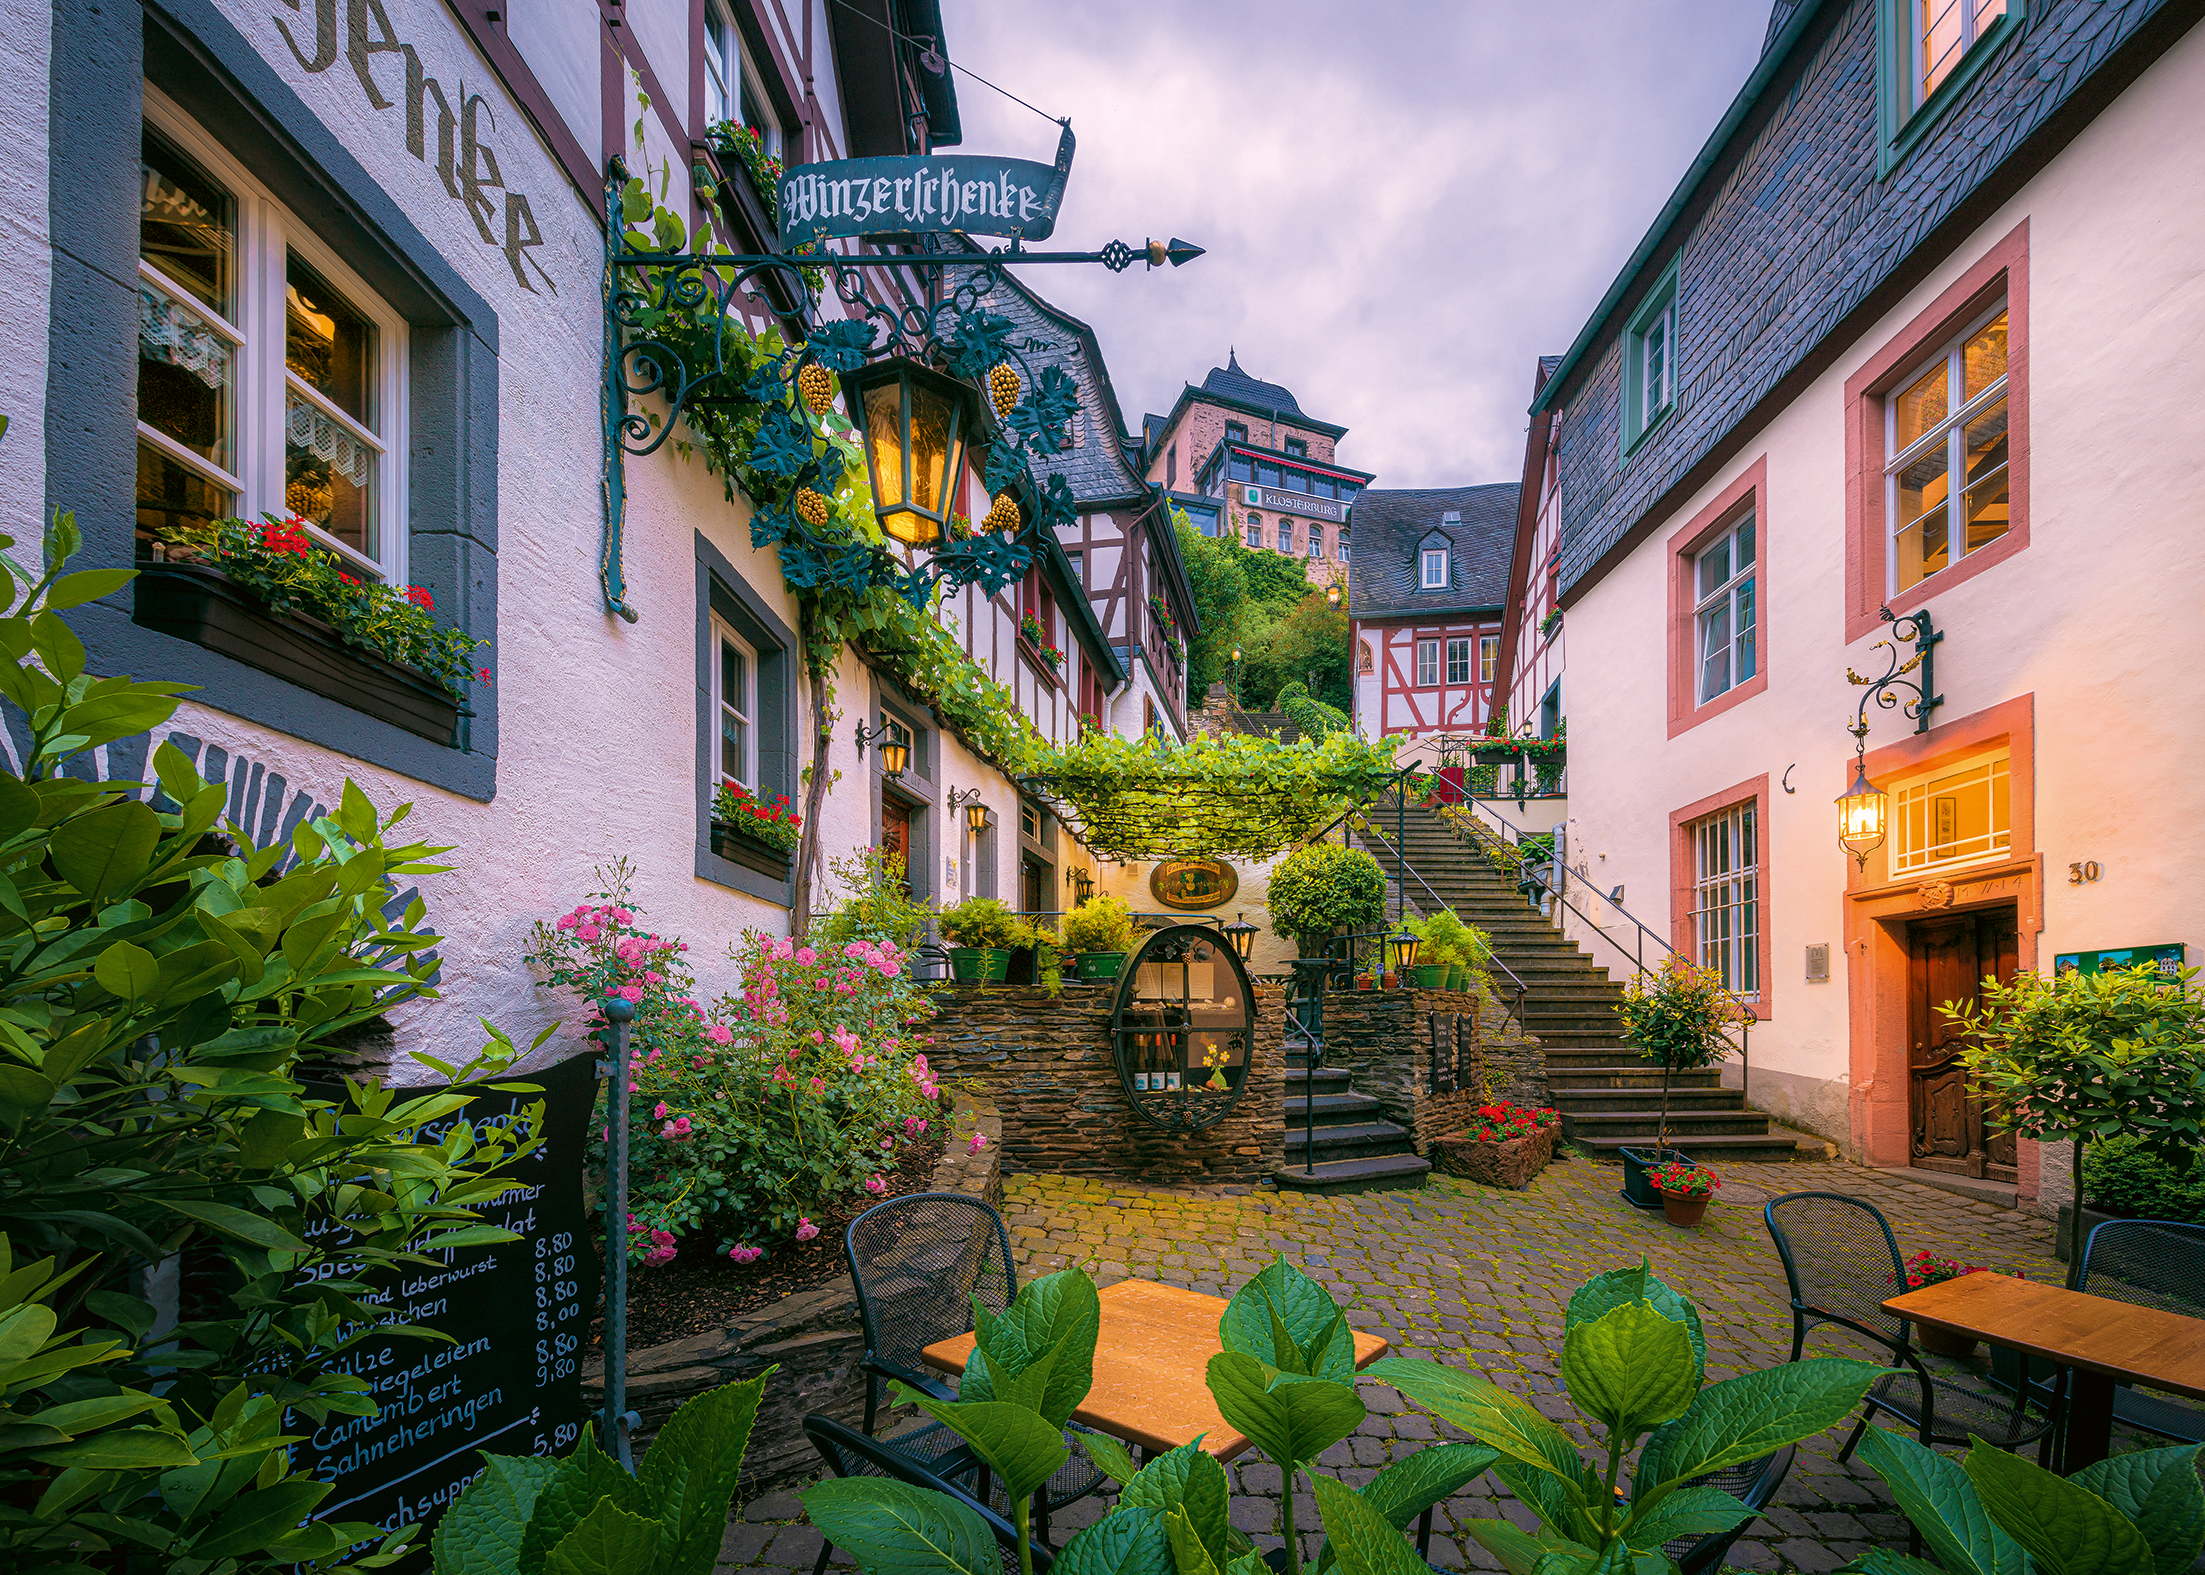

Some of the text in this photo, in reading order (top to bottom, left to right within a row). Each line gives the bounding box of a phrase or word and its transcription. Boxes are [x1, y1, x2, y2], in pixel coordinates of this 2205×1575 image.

[783, 166, 1043, 233] Winzerschenke
[1265, 493, 1338, 517] KLOSTERBURG
[2067, 860, 2099, 884] 30
[401, 1255, 498, 1298] leberwurst
[535, 1231, 573, 1259] 8,80
[535, 1254, 575, 1283] 8,80
[535, 1280, 578, 1308] 8,80
[341, 1302, 580, 1398] iegeleiern 8,00
[536, 1332, 578, 1364] 8,80
[535, 1358, 575, 1388] 9,80
[533, 1422, 577, 1457] 5,80
